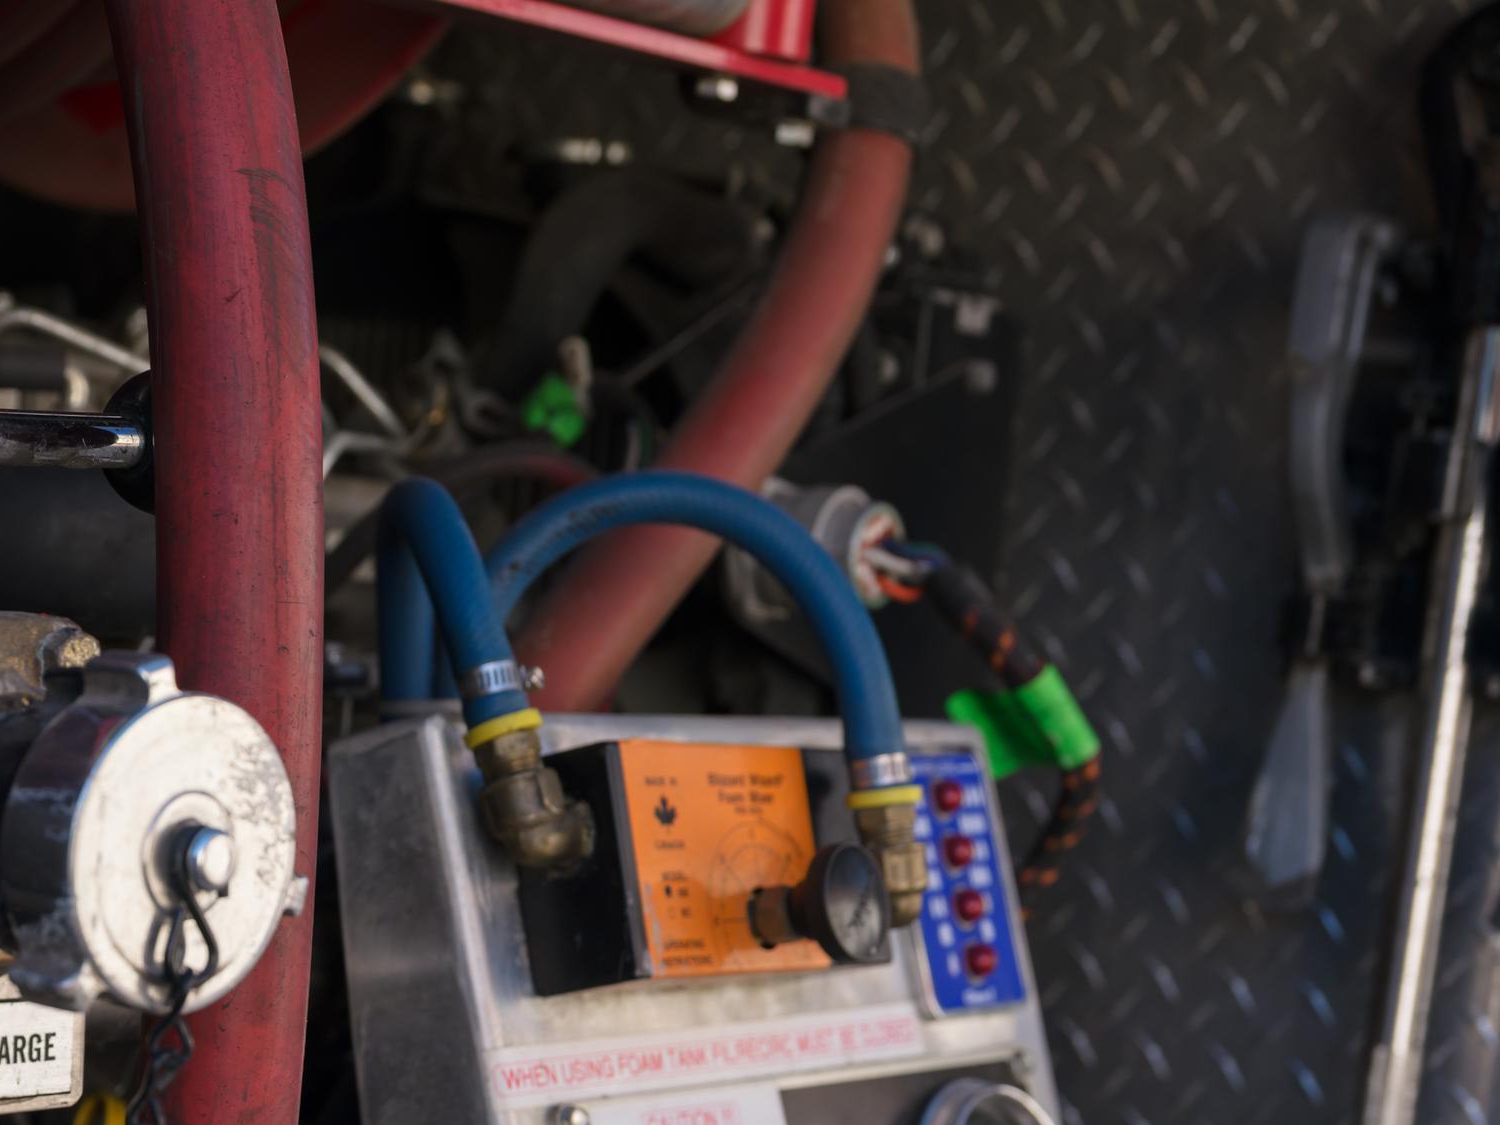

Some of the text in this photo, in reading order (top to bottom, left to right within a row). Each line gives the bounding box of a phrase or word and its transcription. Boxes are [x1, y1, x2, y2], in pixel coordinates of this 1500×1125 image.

[501, 1058, 557, 1090] WHEN
[562, 1053, 616, 1086] USING
[618, 1048, 664, 1079] FOAM
